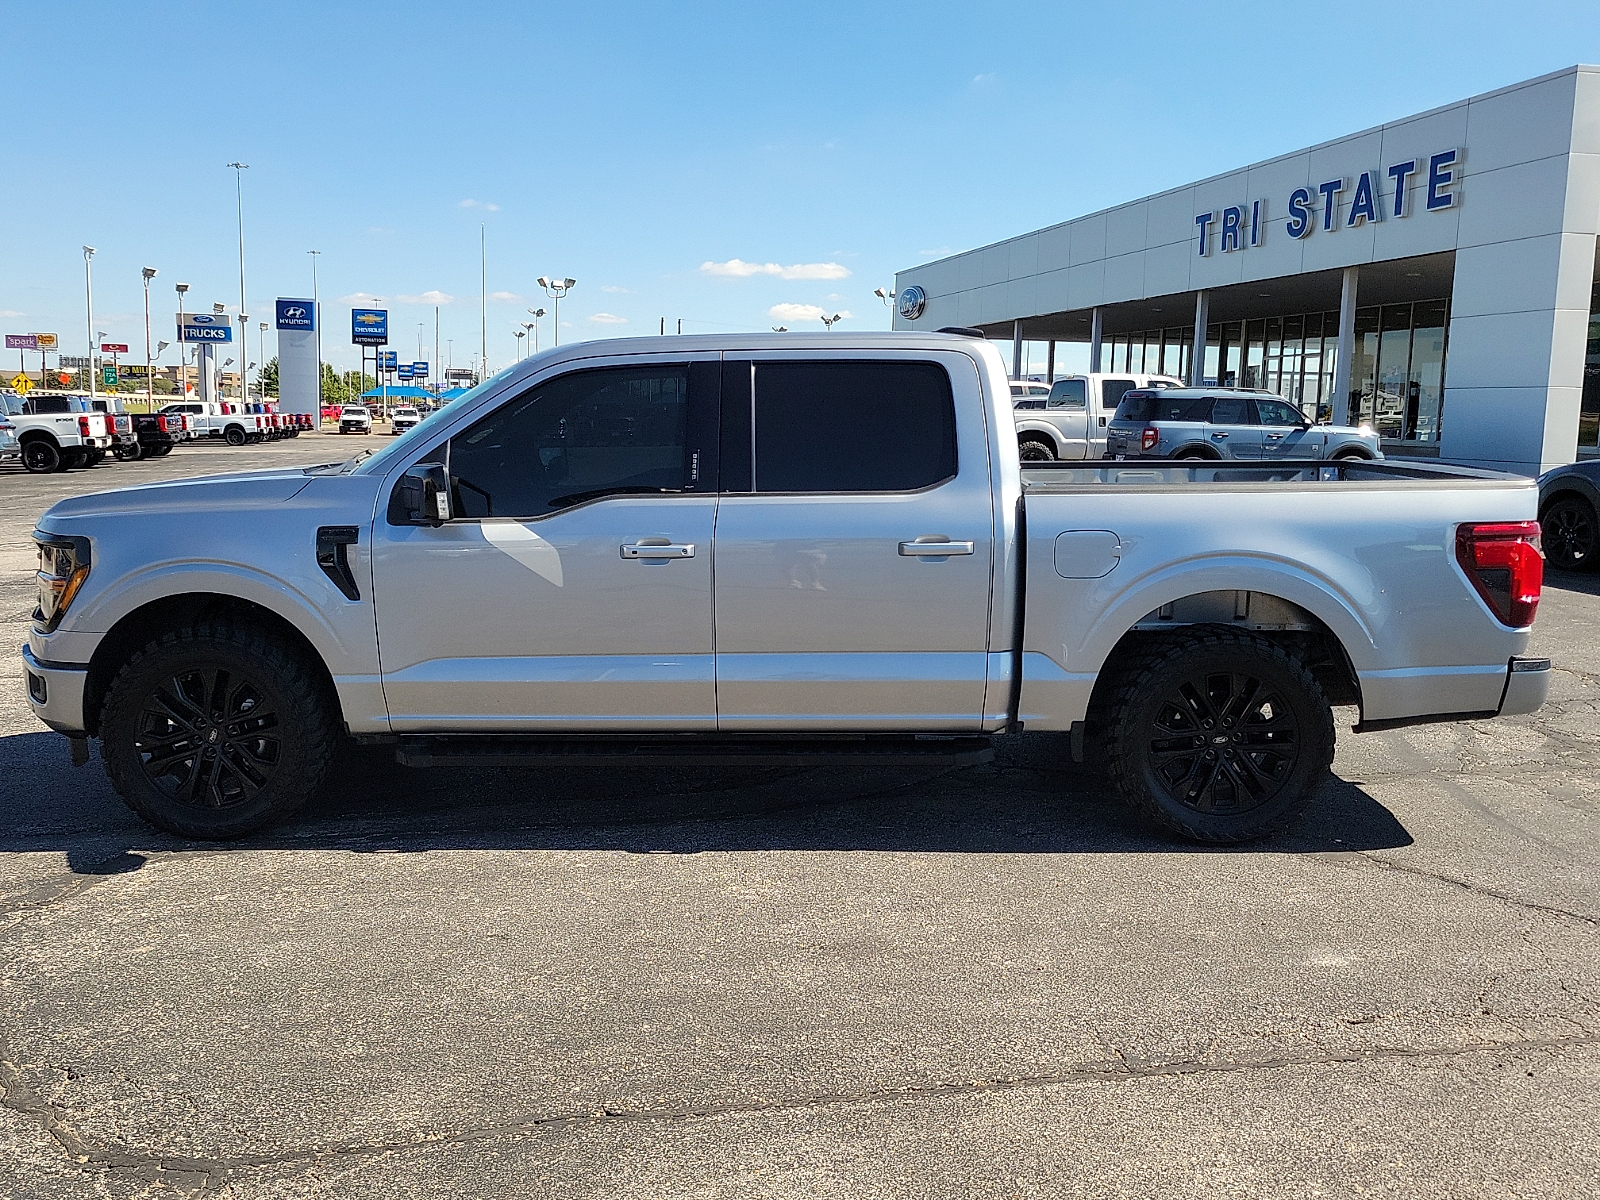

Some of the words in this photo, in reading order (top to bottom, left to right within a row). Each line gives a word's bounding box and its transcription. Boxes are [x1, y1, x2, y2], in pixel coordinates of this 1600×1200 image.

[1195, 198, 1265, 257] TRI
[1286, 147, 1462, 240] STATE
[184, 329, 226, 338] TRUCKS
[9, 337, 35, 346] spark
